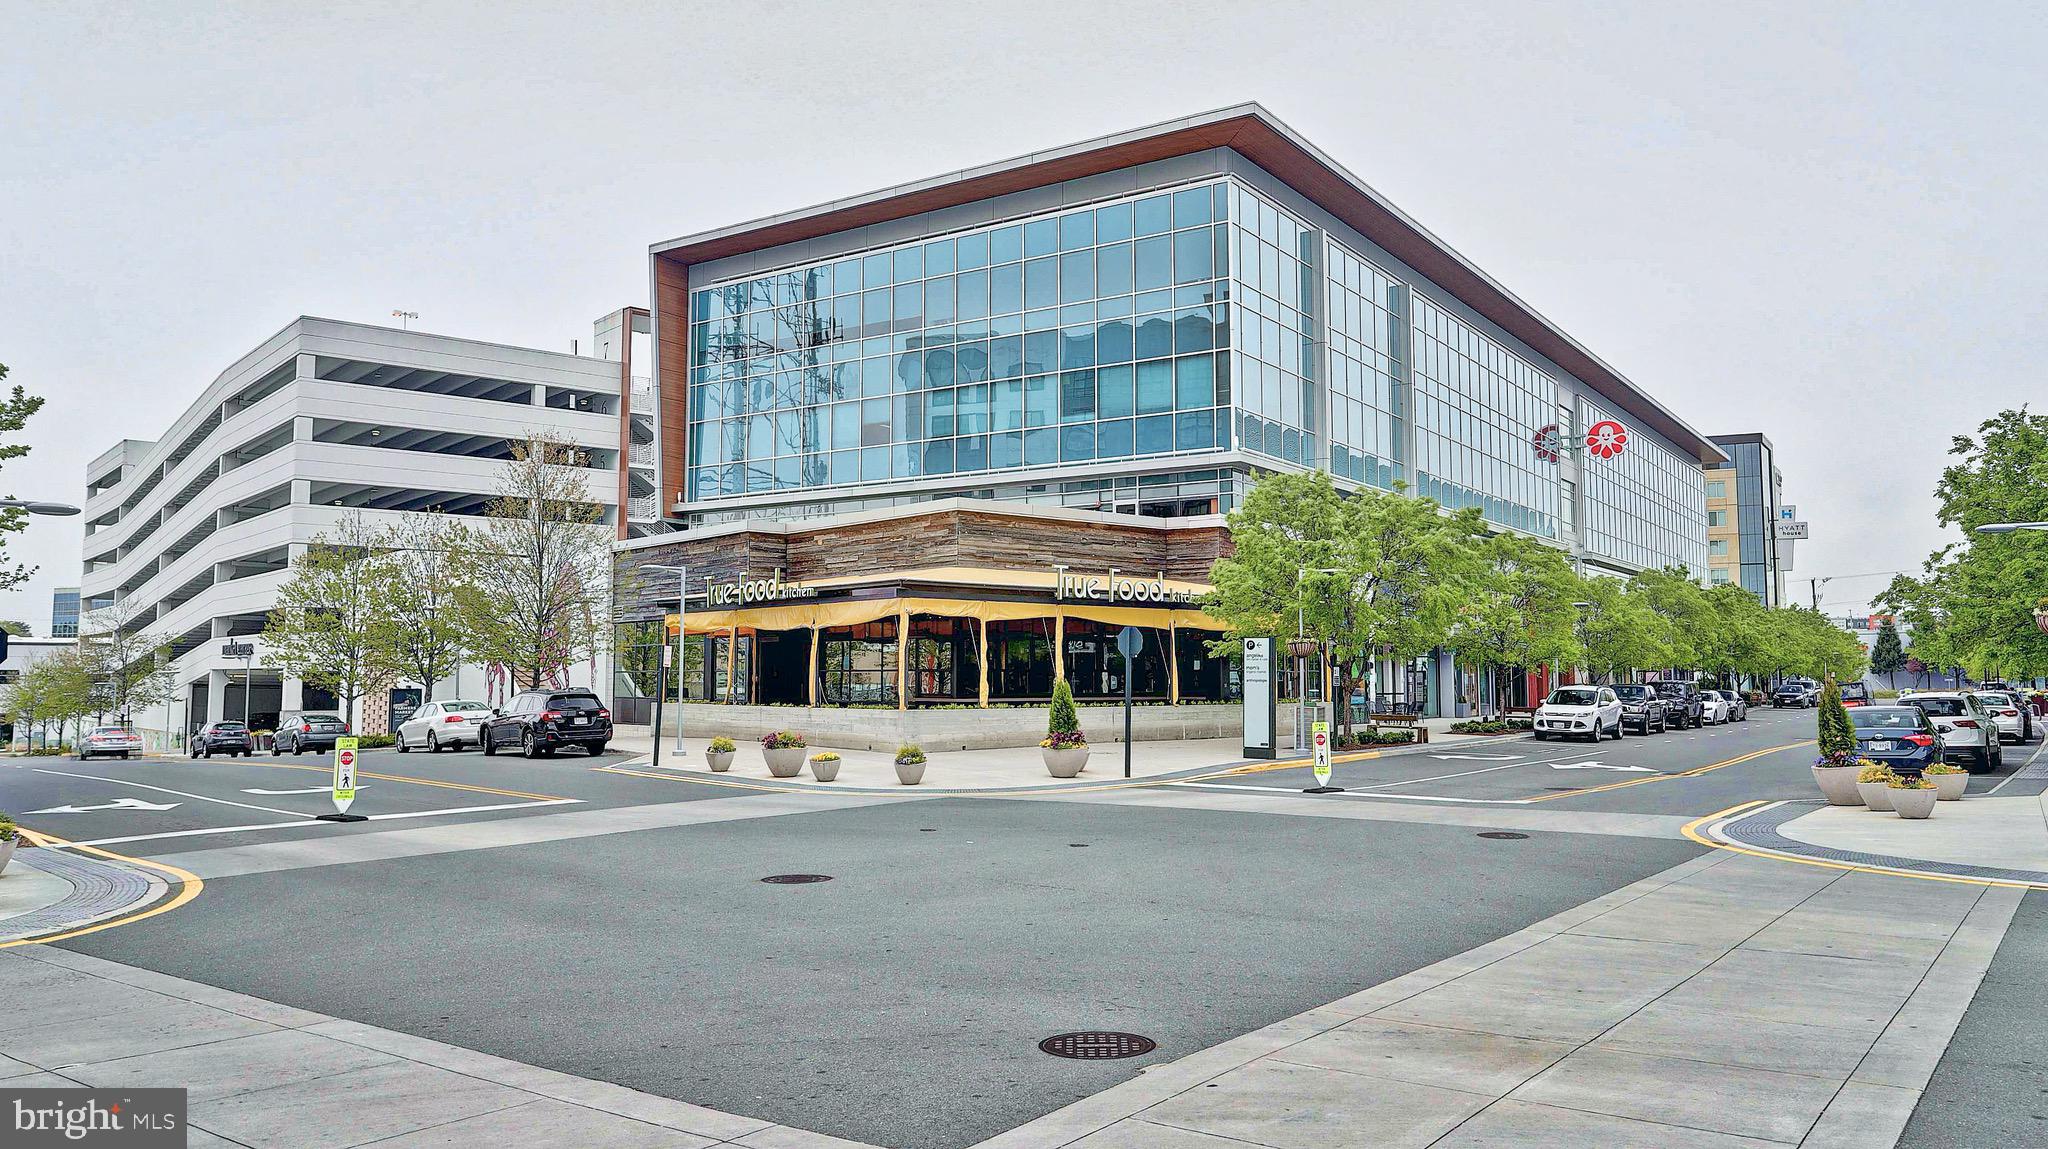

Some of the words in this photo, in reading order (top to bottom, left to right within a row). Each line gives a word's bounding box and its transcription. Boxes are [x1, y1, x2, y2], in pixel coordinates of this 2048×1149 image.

[603, 341, 609, 360] 7
[1778, 524, 1805, 532] HYATT
[703, 575, 736, 609] True
[738, 567, 781, 606] Food
[781, 582, 818, 600] kitchen
[1051, 564, 1101, 601] True
[1108, 567, 1164, 603] Food
